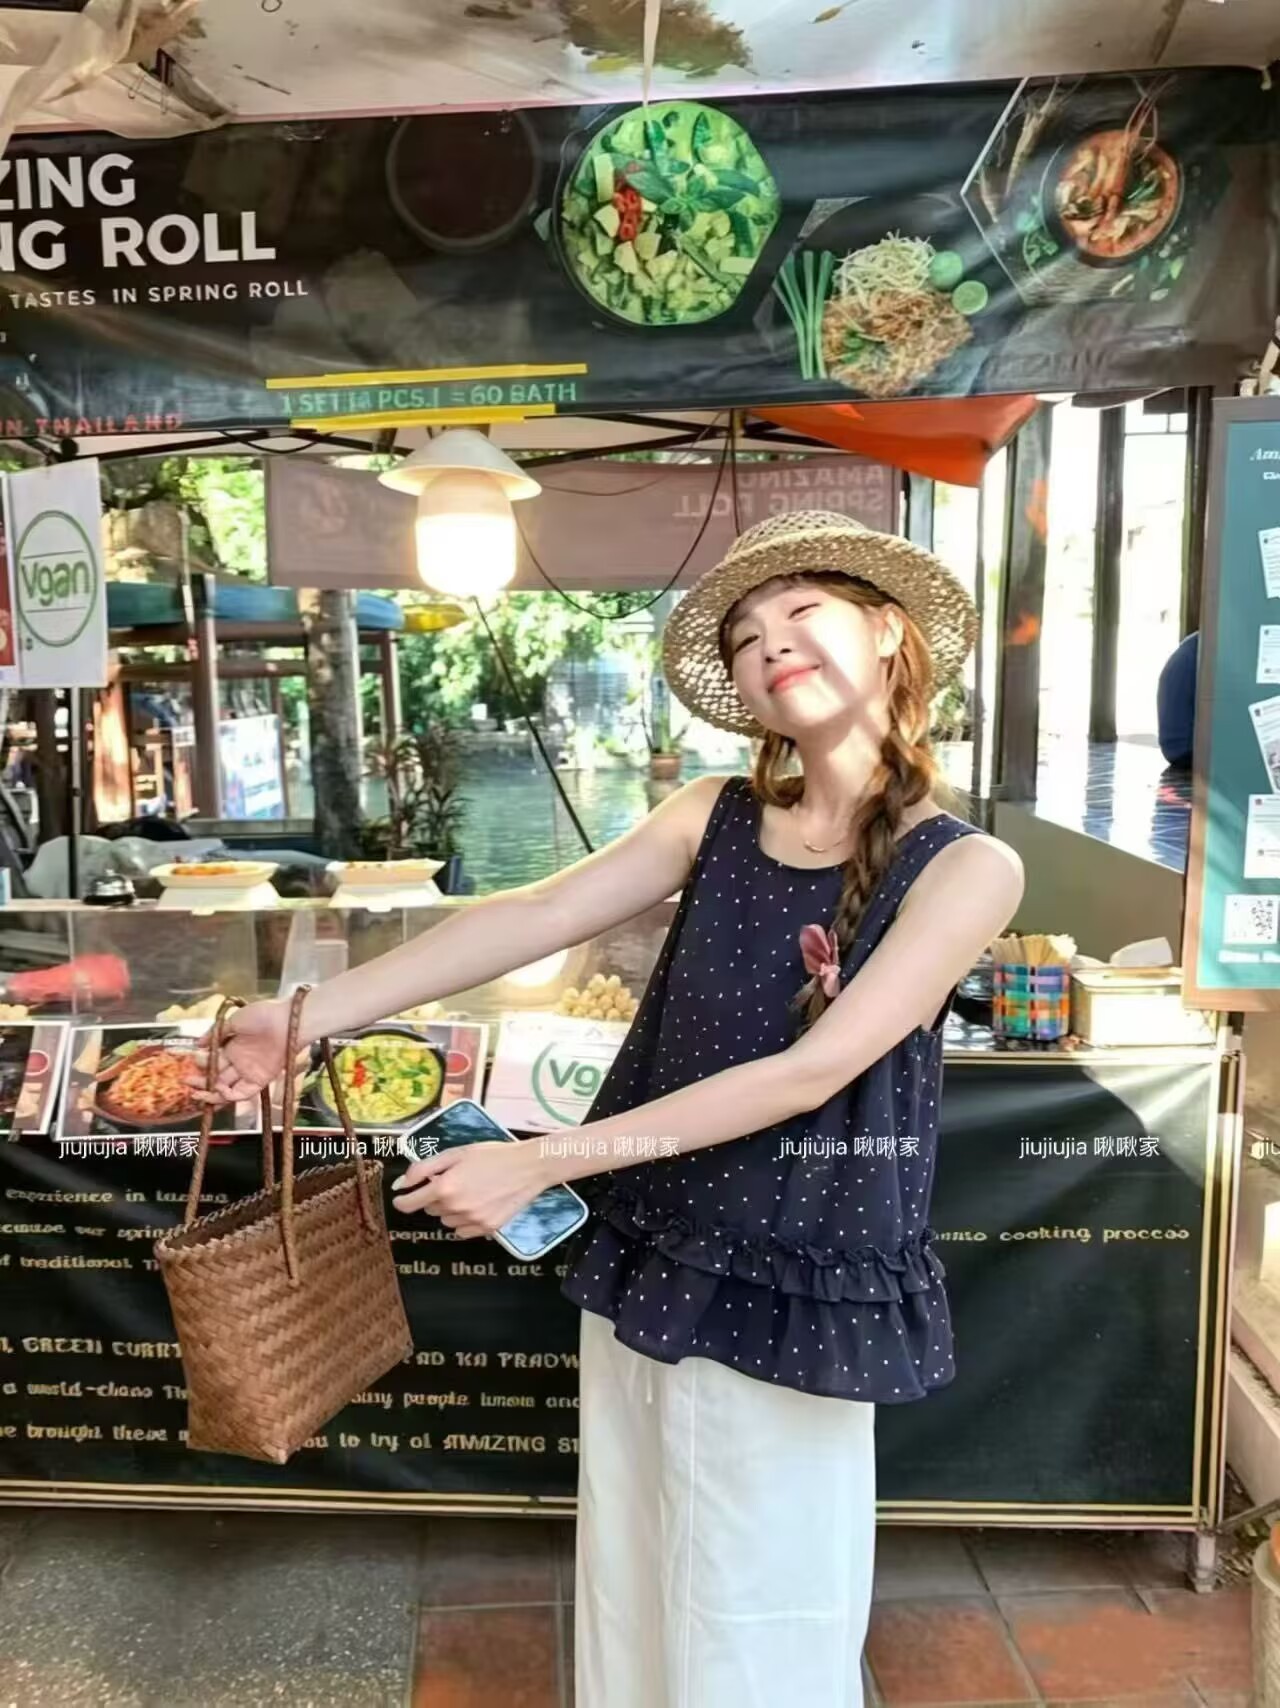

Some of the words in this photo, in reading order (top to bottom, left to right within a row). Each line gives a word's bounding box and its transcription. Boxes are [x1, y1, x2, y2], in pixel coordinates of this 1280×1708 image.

[101, 211, 276, 268] ROLL
[9, 290, 96, 310] TASTES
[113, 287, 138, 304] IN
[148, 283, 239, 303] SPRING
[249, 279, 309, 299] ROLL
[470, 384, 504, 406] 60
[511, 381, 577, 405] BATH
[36, 411, 185, 436] THAILAND
[125, 1188, 146, 1203] in
[1000, 1226, 1092, 1243] cooking
[451, 1261, 498, 1277] that
[507, 1264, 544, 1277] are
[302, 1436, 329, 1449] ou
[340, 1433, 360, 1449] to
